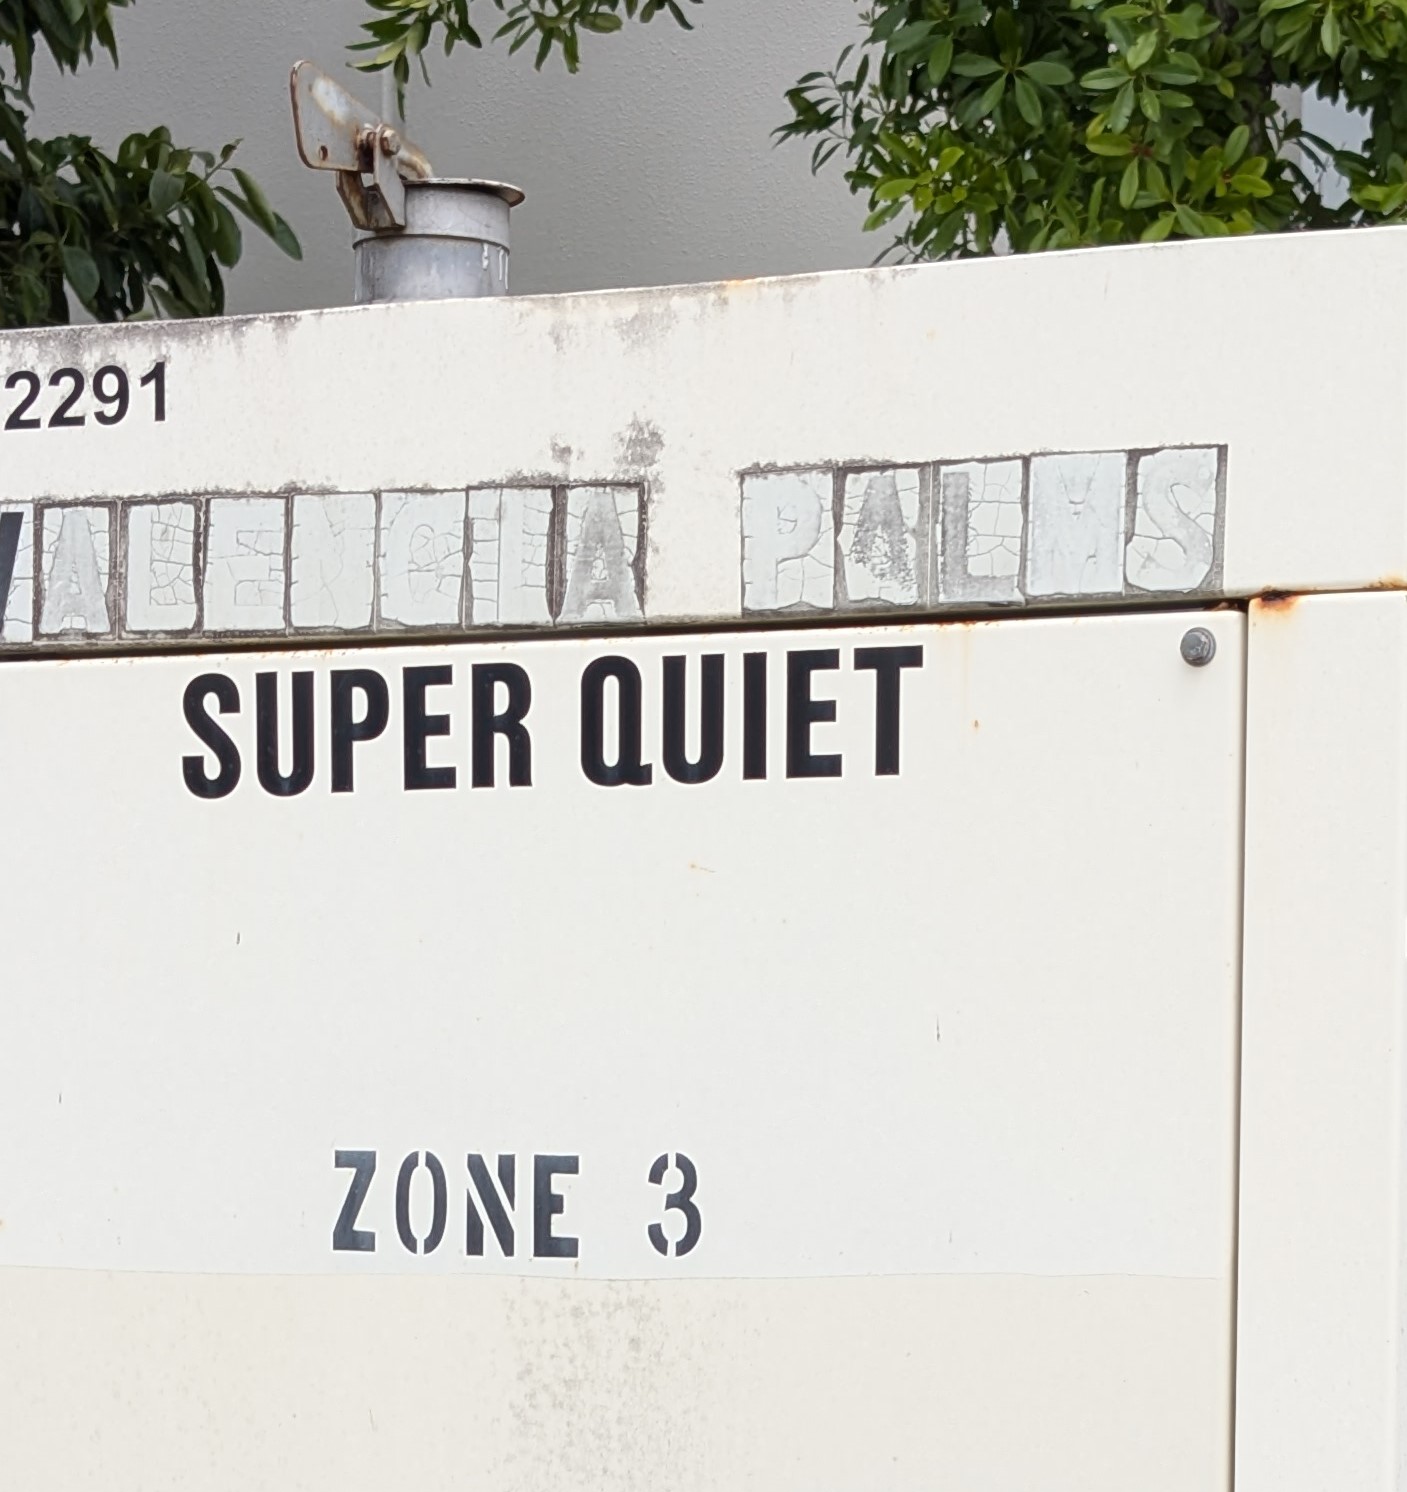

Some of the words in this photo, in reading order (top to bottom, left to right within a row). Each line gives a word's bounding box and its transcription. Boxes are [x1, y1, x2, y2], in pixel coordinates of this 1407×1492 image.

[182, 662, 532, 800] SUPER
[580, 645, 924, 787] QUIET
[332, 1149, 579, 1258] ZONE
[647, 1152, 702, 1257] 3
